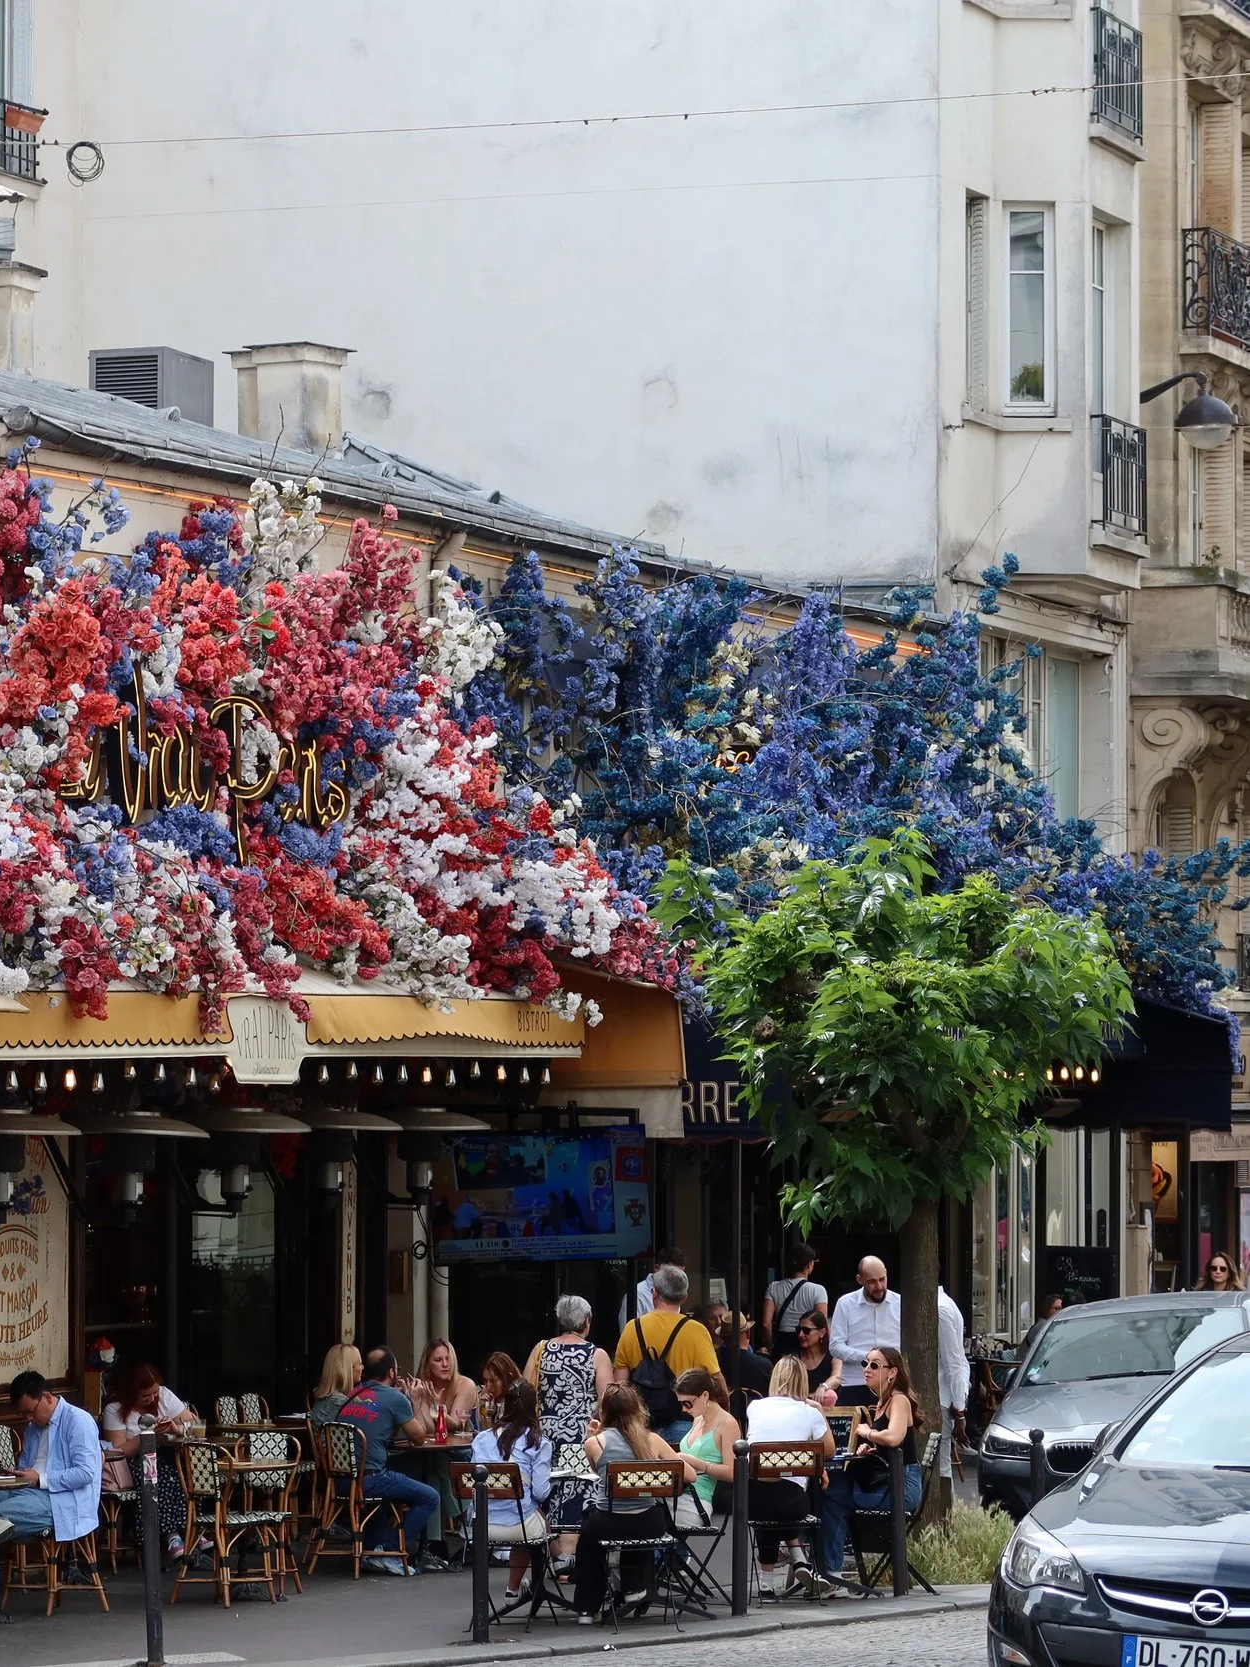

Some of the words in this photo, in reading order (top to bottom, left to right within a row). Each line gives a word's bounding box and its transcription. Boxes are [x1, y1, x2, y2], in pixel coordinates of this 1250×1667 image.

[236, 1006, 263, 1059] VRAI
[517, 1010, 550, 1032] BISTROT
[20, 1239, 39, 1265] FRAIS
[9, 1262, 17, 1282] &
[6, 1279, 39, 1314] MAISON
[18, 1301, 49, 1342] HEURE
[1126, 1656, 1131, 1664] F
